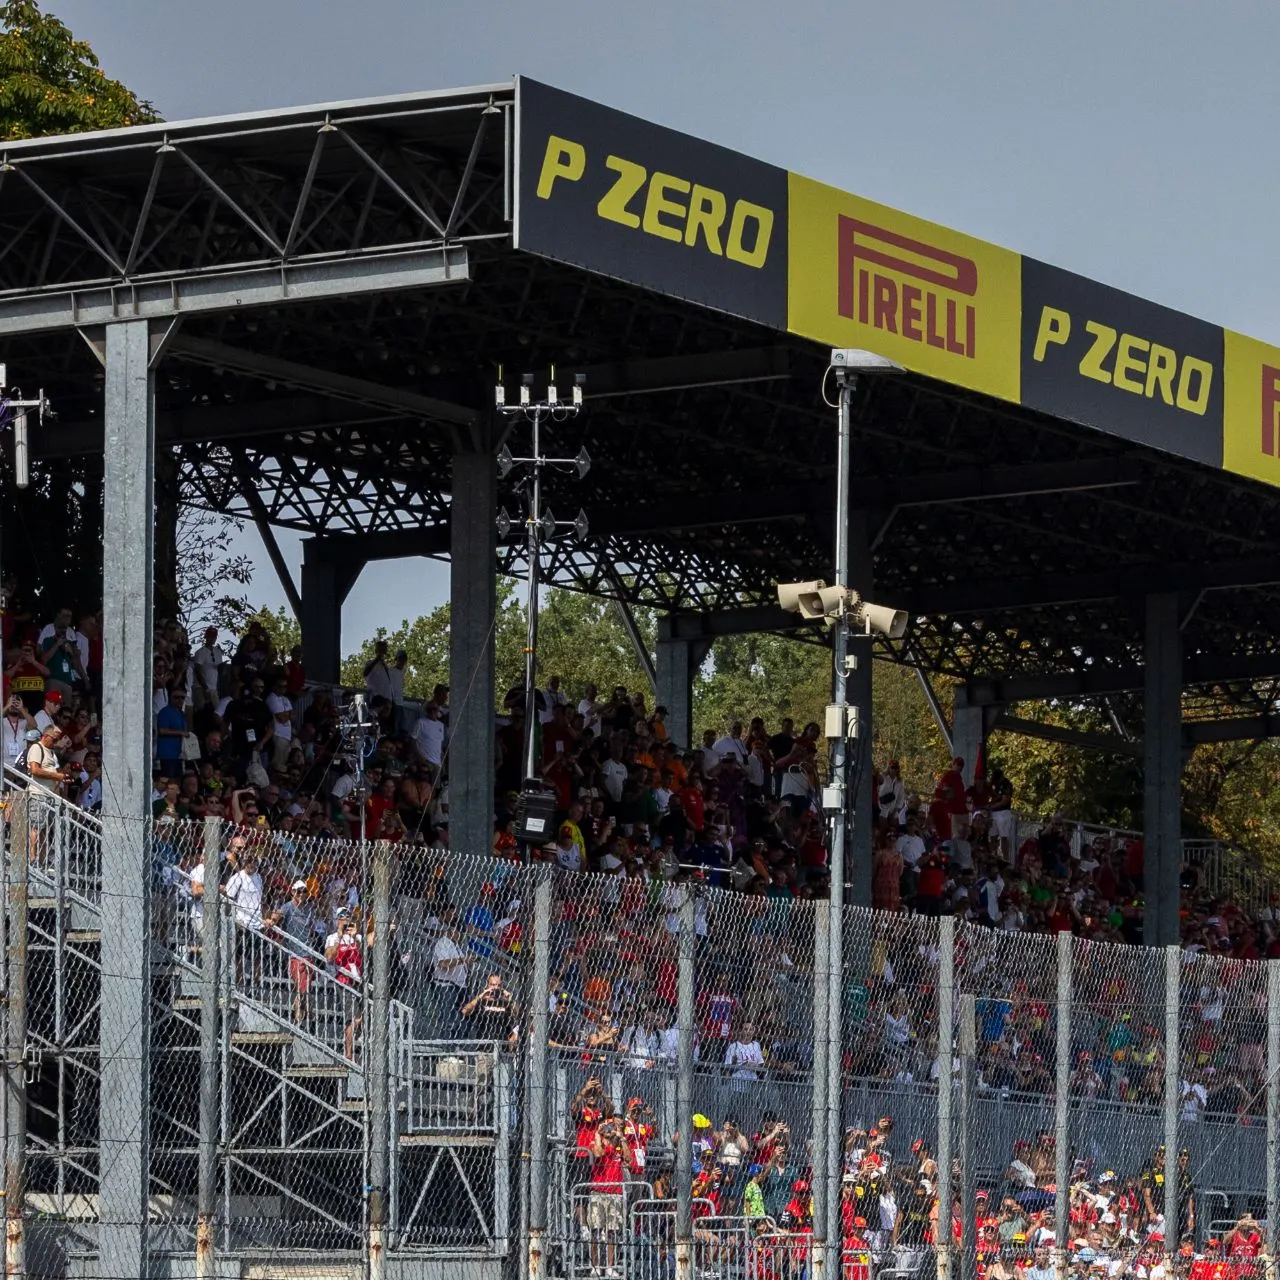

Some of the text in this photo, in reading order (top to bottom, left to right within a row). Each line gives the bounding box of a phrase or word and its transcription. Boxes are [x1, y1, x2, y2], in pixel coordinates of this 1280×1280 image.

[537, 136, 772, 267] P ZERO
[838, 216, 977, 356] PIRELLI
[1034, 307, 1212, 414] P ZERO
